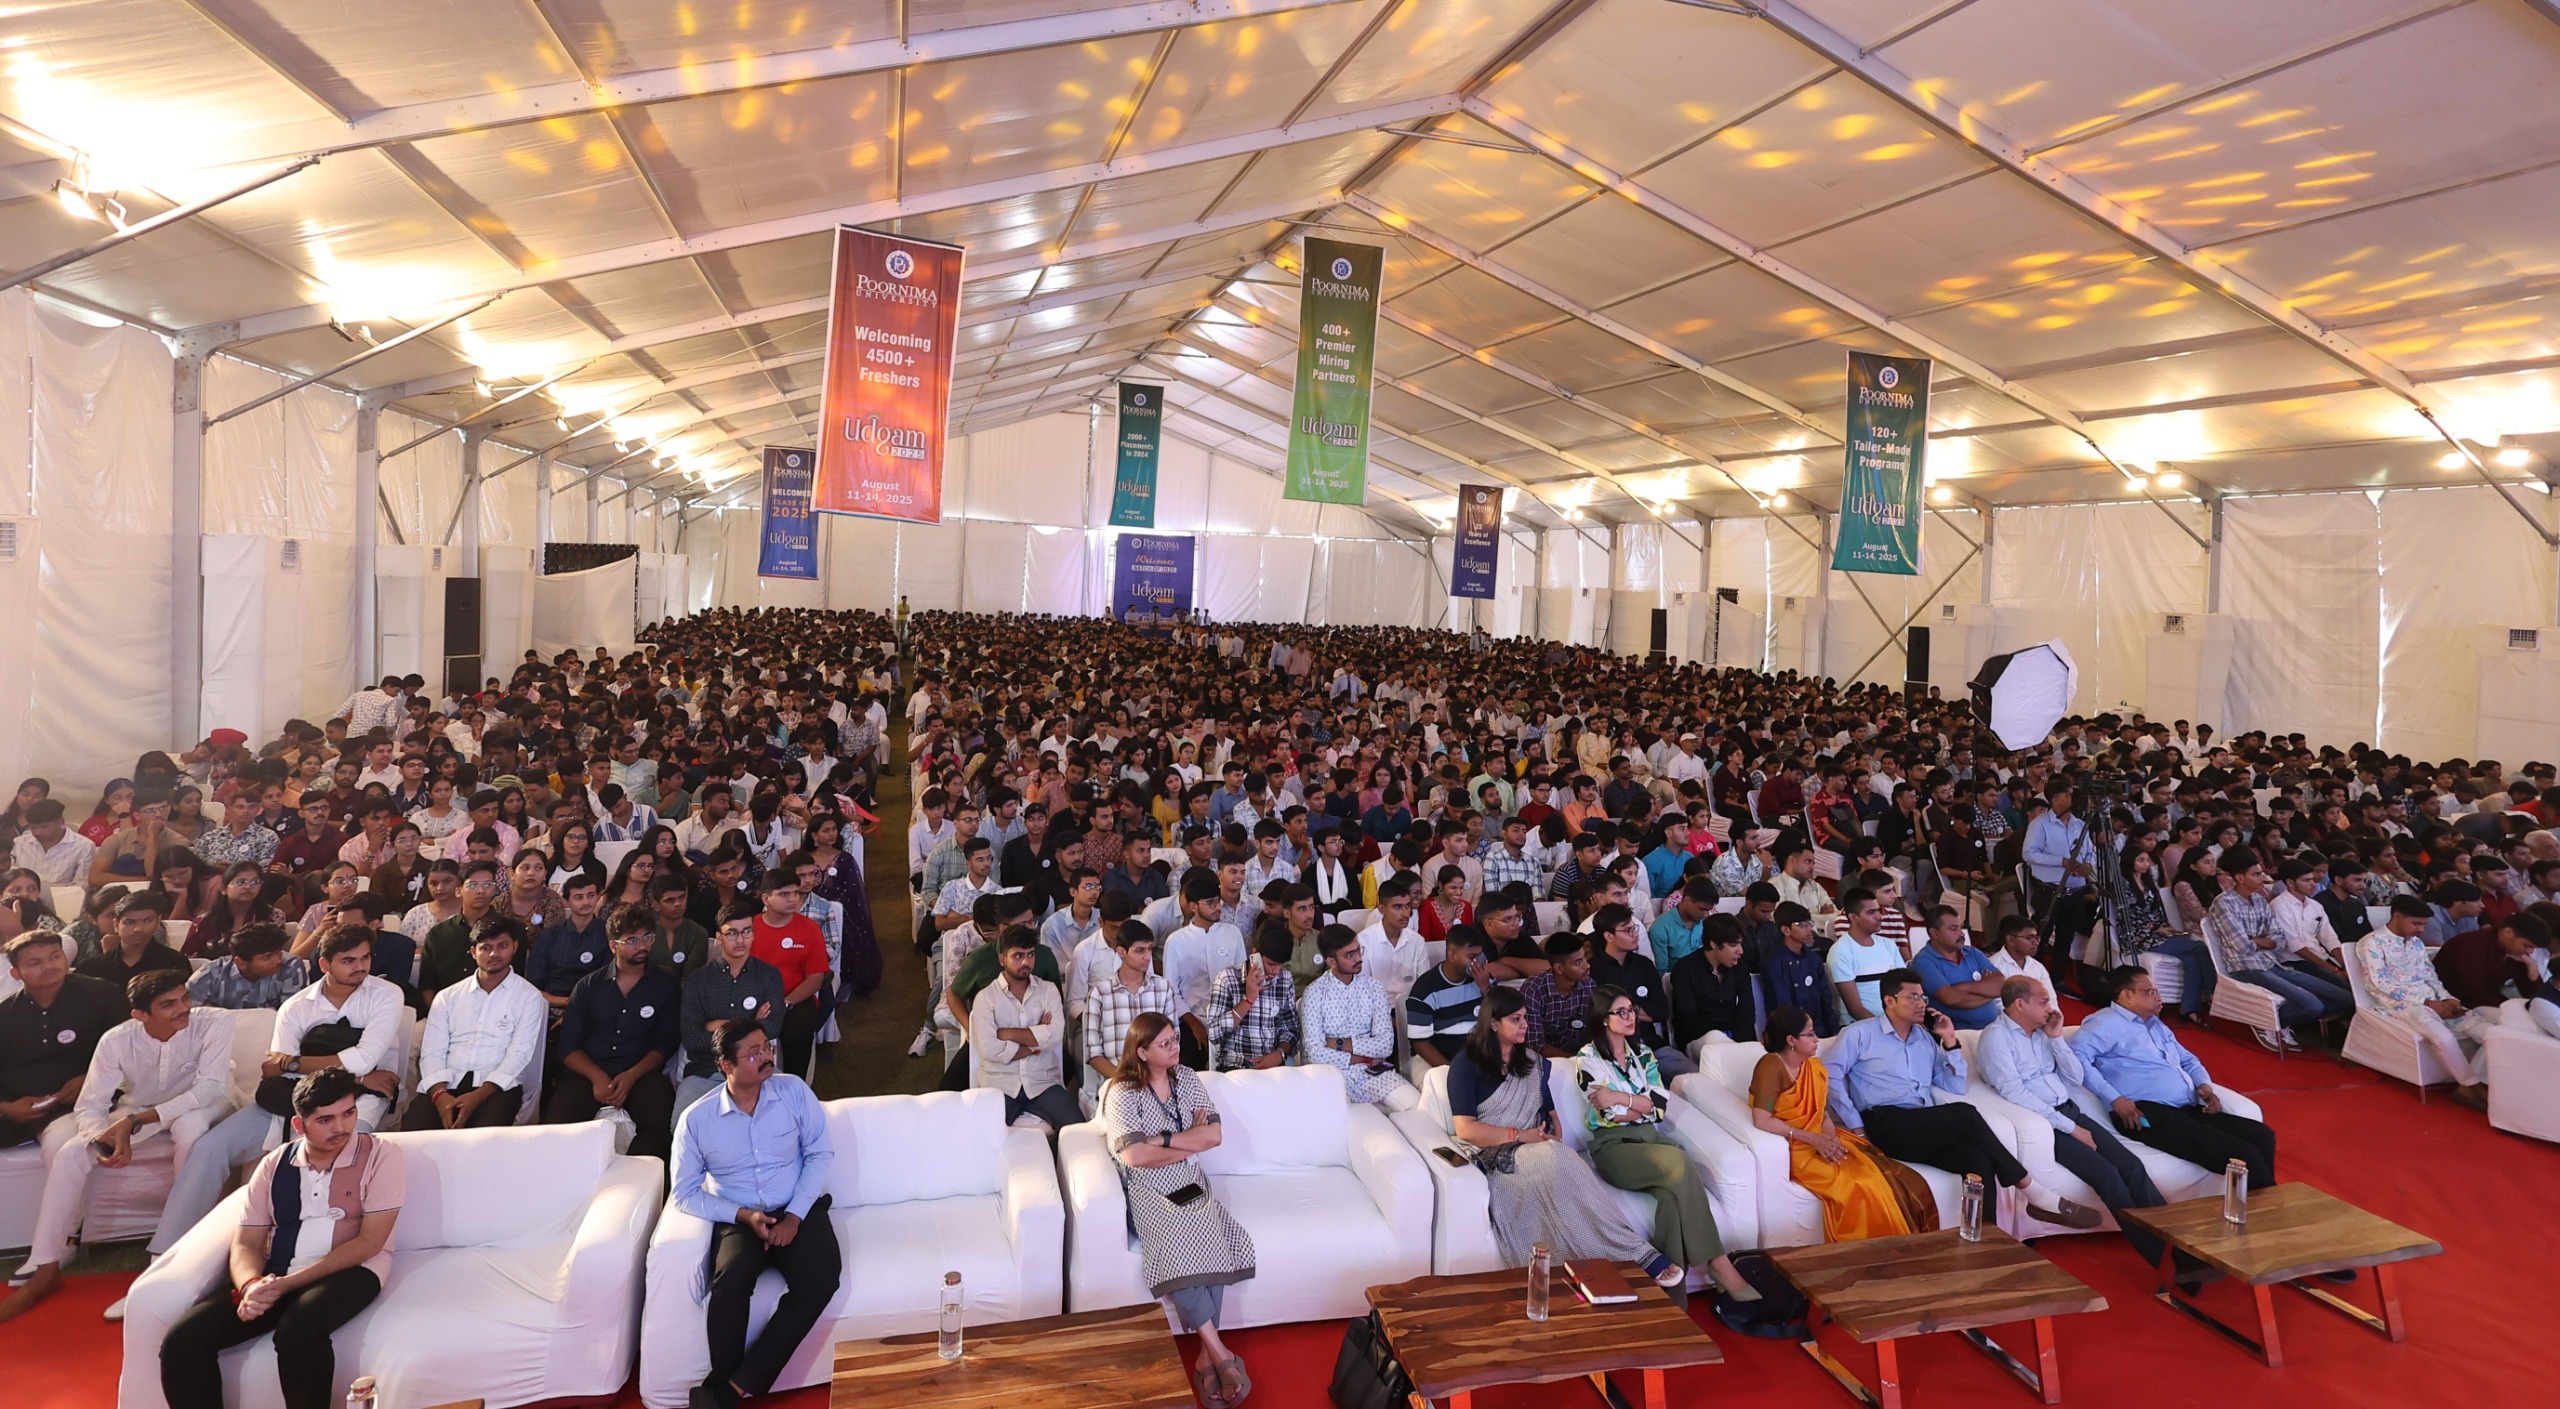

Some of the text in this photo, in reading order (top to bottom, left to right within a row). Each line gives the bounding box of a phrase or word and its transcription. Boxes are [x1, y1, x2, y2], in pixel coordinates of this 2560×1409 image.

[856, 274, 938, 300] POORNIMA
[1312, 278, 1370, 298] POORNIMA
[856, 290, 938, 308] UNIVERSITY
[1312, 290, 1370, 302] UNIVERSITY
[1322, 324, 1350, 337] 400+
[854, 326, 932, 352] Welcoming
[1316, 338, 1356, 353] Premier
[866, 348, 916, 367] 4500+
[1319, 354, 1350, 370] Hiring
[860, 367, 920, 388] Freshers
[1312, 368, 1356, 384] Partners
[1860, 386, 1914, 404] POORNIMA
[1859, 398, 1914, 410] UNIVERSITY
[844, 416, 926, 456] Udgam
[1301, 415, 1358, 444] Udgam
[1872, 426, 1898, 439] 120+
[1126, 433, 1148, 442] 2000+
[1120, 441, 1154, 450] Placements
[892, 447, 924, 459] 2025
[1133, 450, 1148, 458] 2024
[1859, 455, 1905, 470] Programs
[1312, 468, 1340, 478] August
[862, 479, 900, 492] August
[1329, 480, 1349, 488] 2025
[772, 488, 812, 498] WELCOMES
[846, 490, 912, 505] 11-14, 2025
[772, 506, 808, 518] 2025
[1850, 496, 1906, 524] Udgam
[1143, 538, 1180, 548] POORNIMA
[1464, 538, 1491, 546] Excellence
[1862, 542, 1888, 552] August
[1135, 554, 1174, 565] Welcomes
[1852, 551, 1898, 562] 11-14, 2025
[1132, 583, 1174, 603] Udgam
